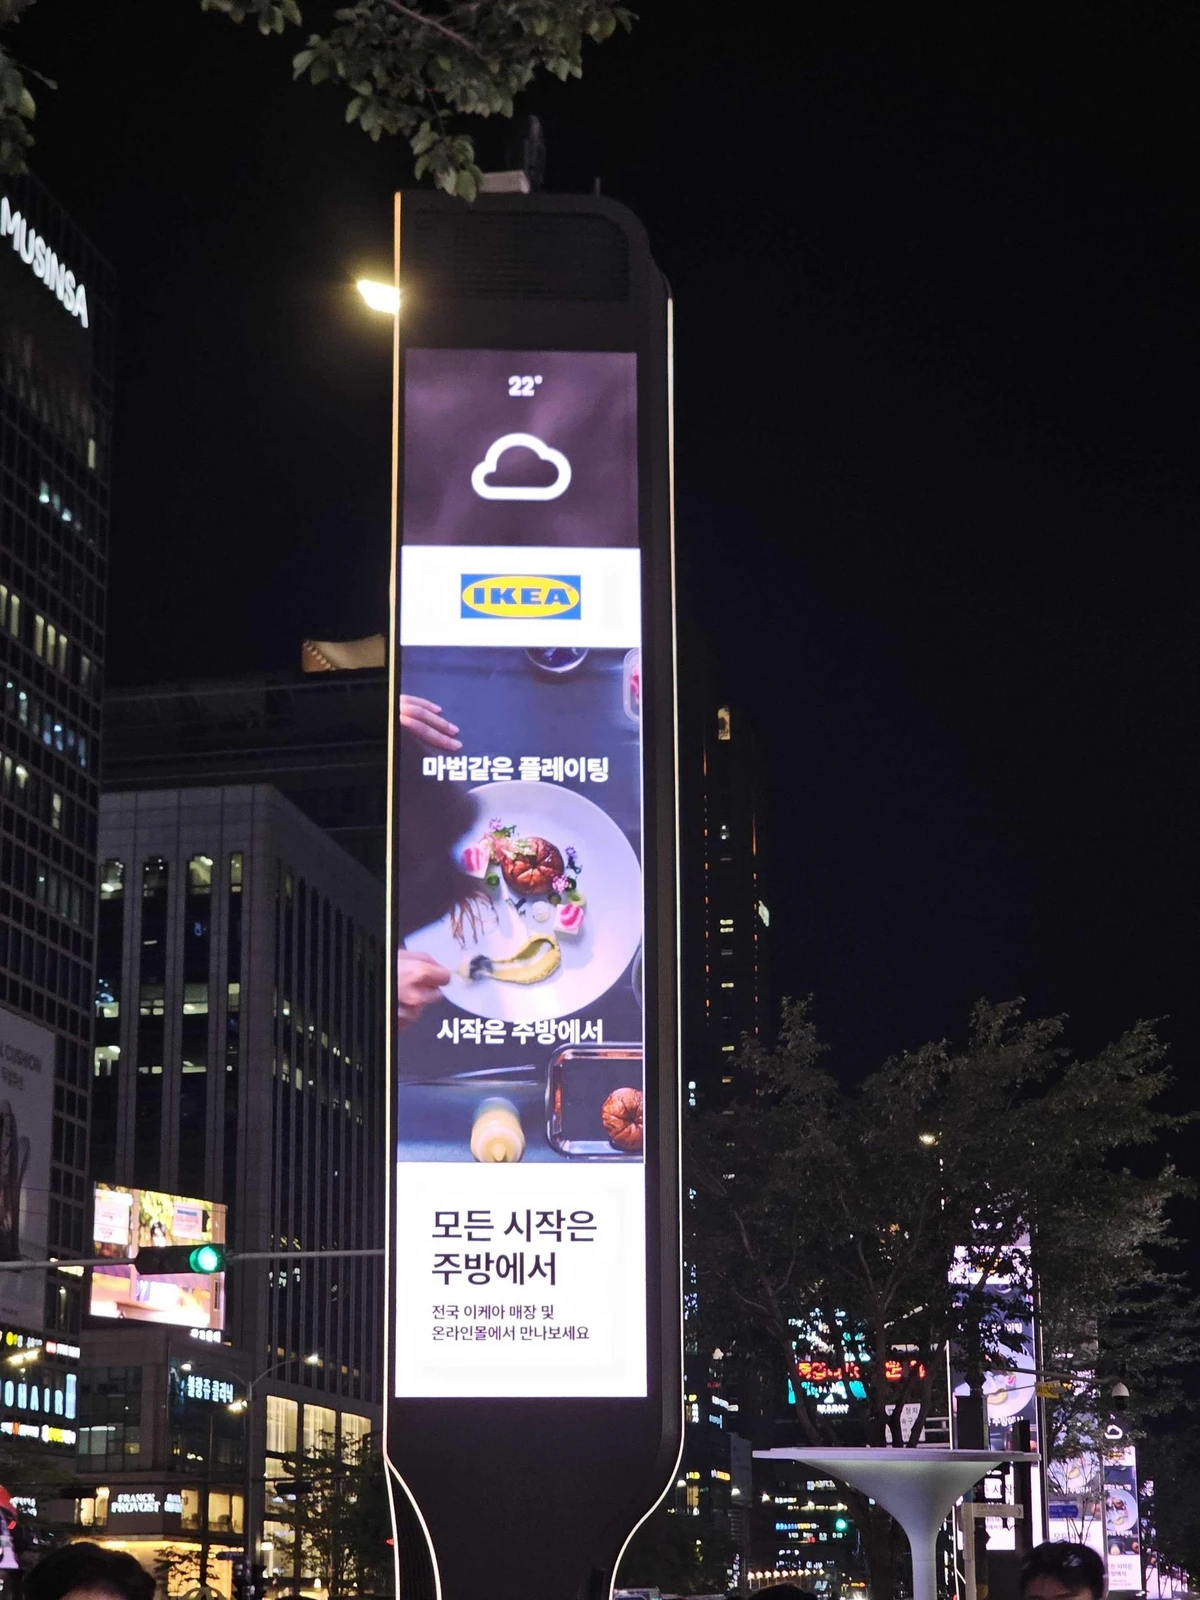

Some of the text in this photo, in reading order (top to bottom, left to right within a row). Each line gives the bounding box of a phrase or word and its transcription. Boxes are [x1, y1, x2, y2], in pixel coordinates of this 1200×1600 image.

[0, 196, 88, 328] MUSINSA
[508, 376, 543, 397] 22°
[473, 587, 571, 606] IKEA
[422, 755, 609, 785] 마법같은 플레이팅
[436, 1017, 604, 1046] 시작은 주방에서
[431, 1209, 598, 1243] 모든 시작은
[431, 1252, 556, 1286] 주방에서
[431, 1304, 554, 1320] 전국 이케아 매장 및
[431, 1325, 590, 1341] 온라인몰에서 만나보세요
[110, 1502, 161, 1514] PROVOST
